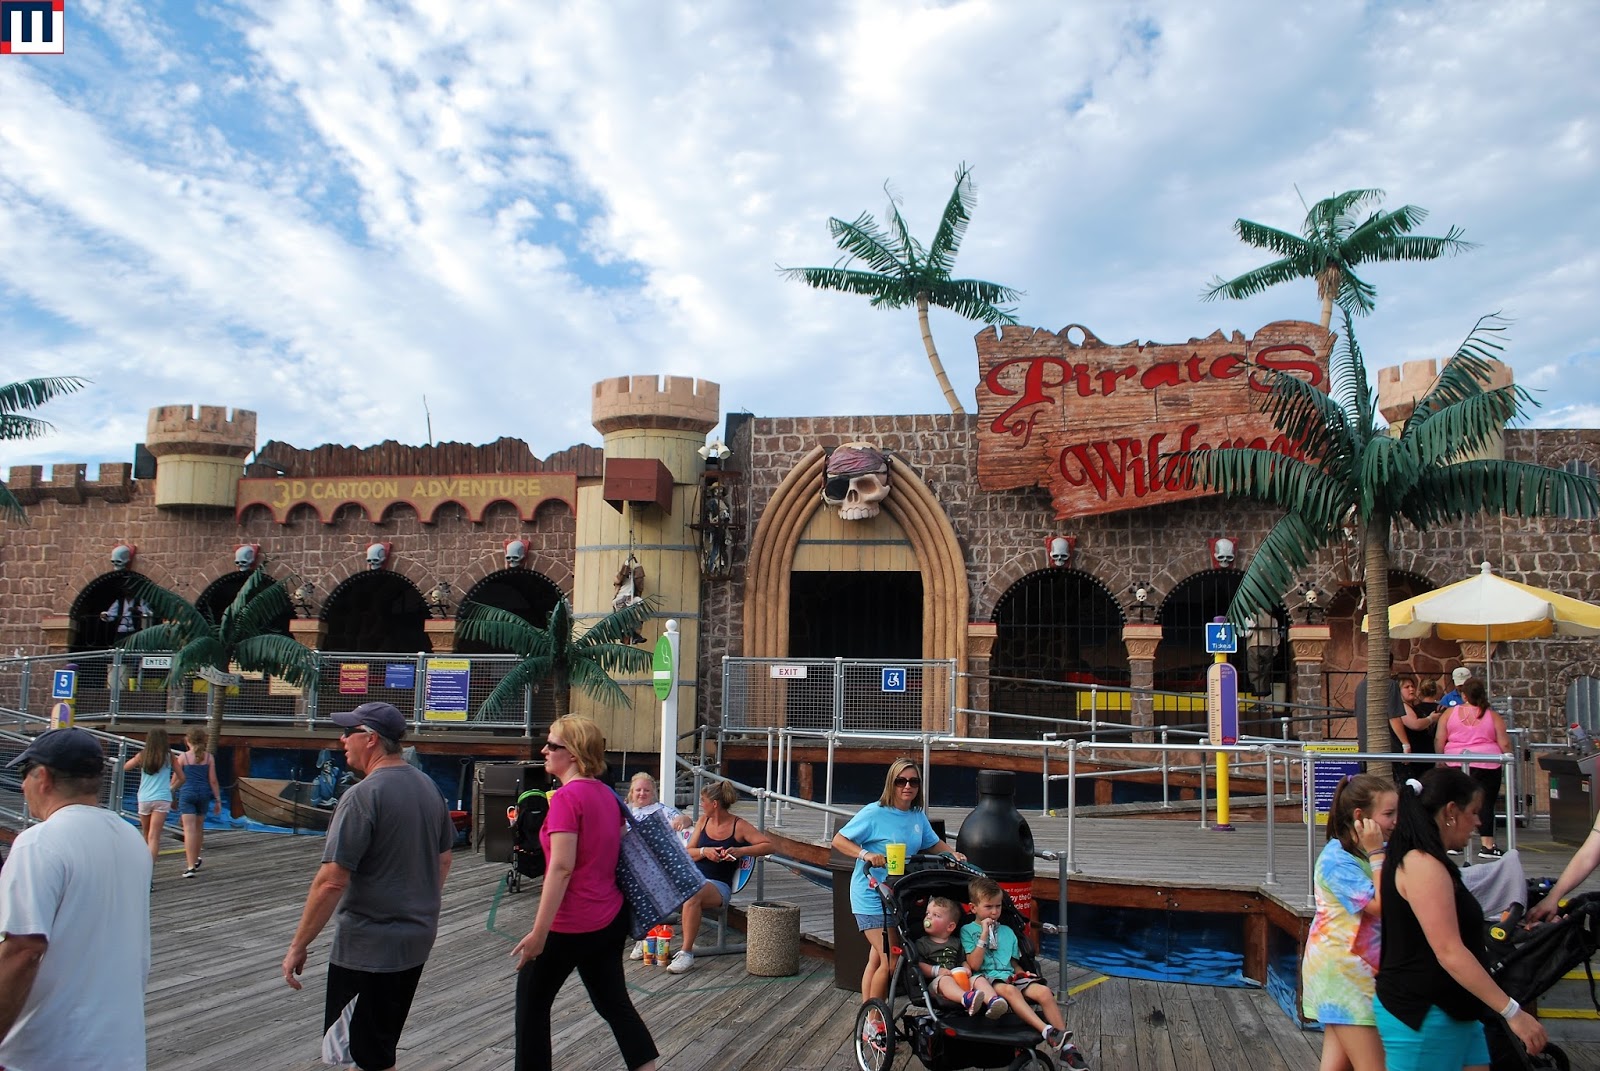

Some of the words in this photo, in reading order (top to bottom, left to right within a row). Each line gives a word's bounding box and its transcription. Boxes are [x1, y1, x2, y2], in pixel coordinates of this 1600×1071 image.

[1011, 409, 1045, 450] of
[274, 482, 306, 509] 3D
[311, 481, 398, 499] CARTOON
[411, 479, 541, 498] ADVENTURE
[1215, 627, 1227, 641] 4
[145, 658, 168, 666] ENTER
[778, 668, 798, 676] EXIT
[60, 674, 68, 688] 5
